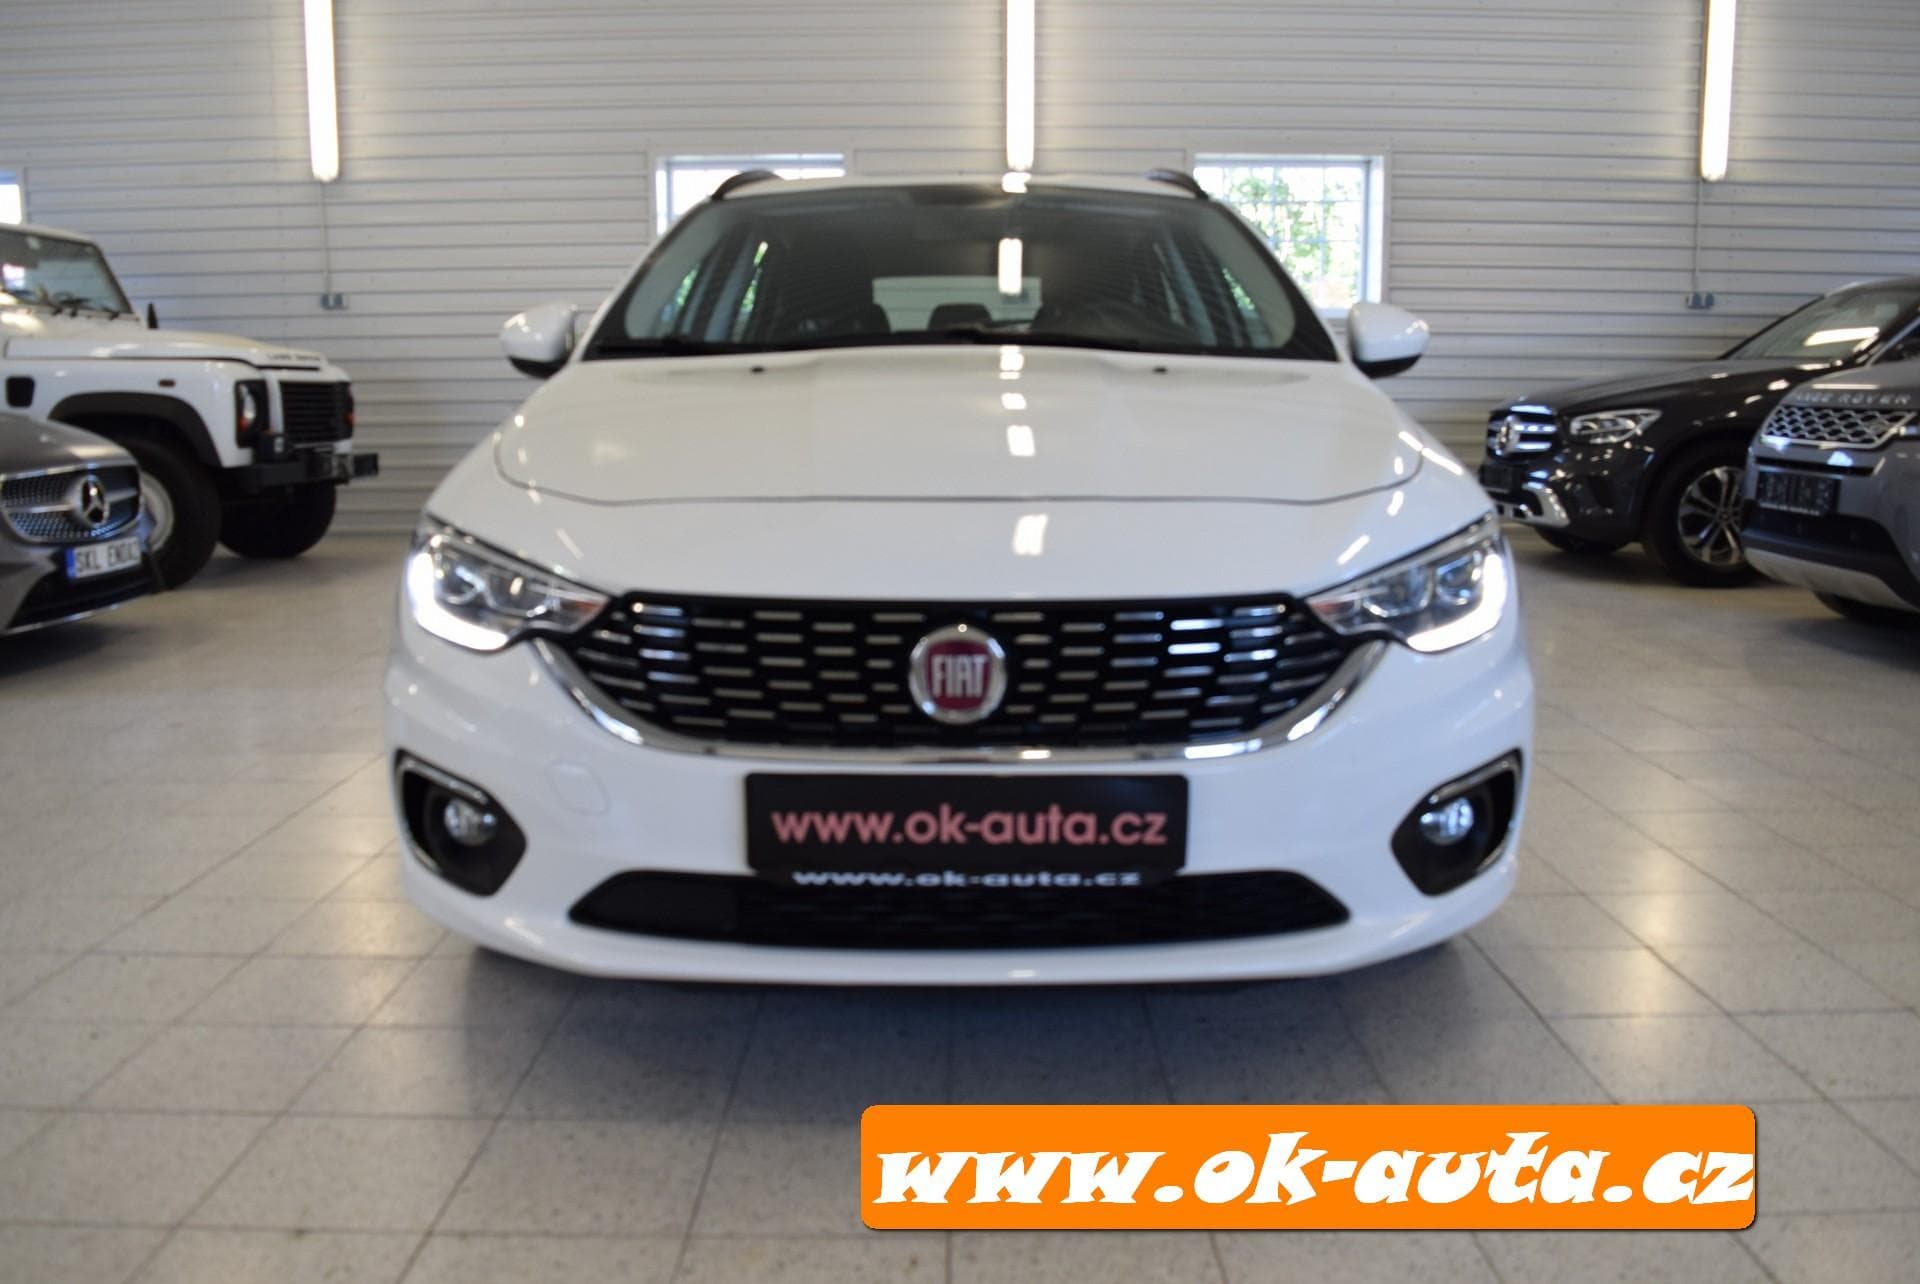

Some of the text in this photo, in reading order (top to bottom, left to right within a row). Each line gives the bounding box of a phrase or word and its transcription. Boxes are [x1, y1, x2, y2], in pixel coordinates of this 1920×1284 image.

[931, 654, 988, 698] FIAT
[771, 804, 1167, 845] www.ok-auta.cz
[791, 869, 1141, 887] www.ok-auta.cz
